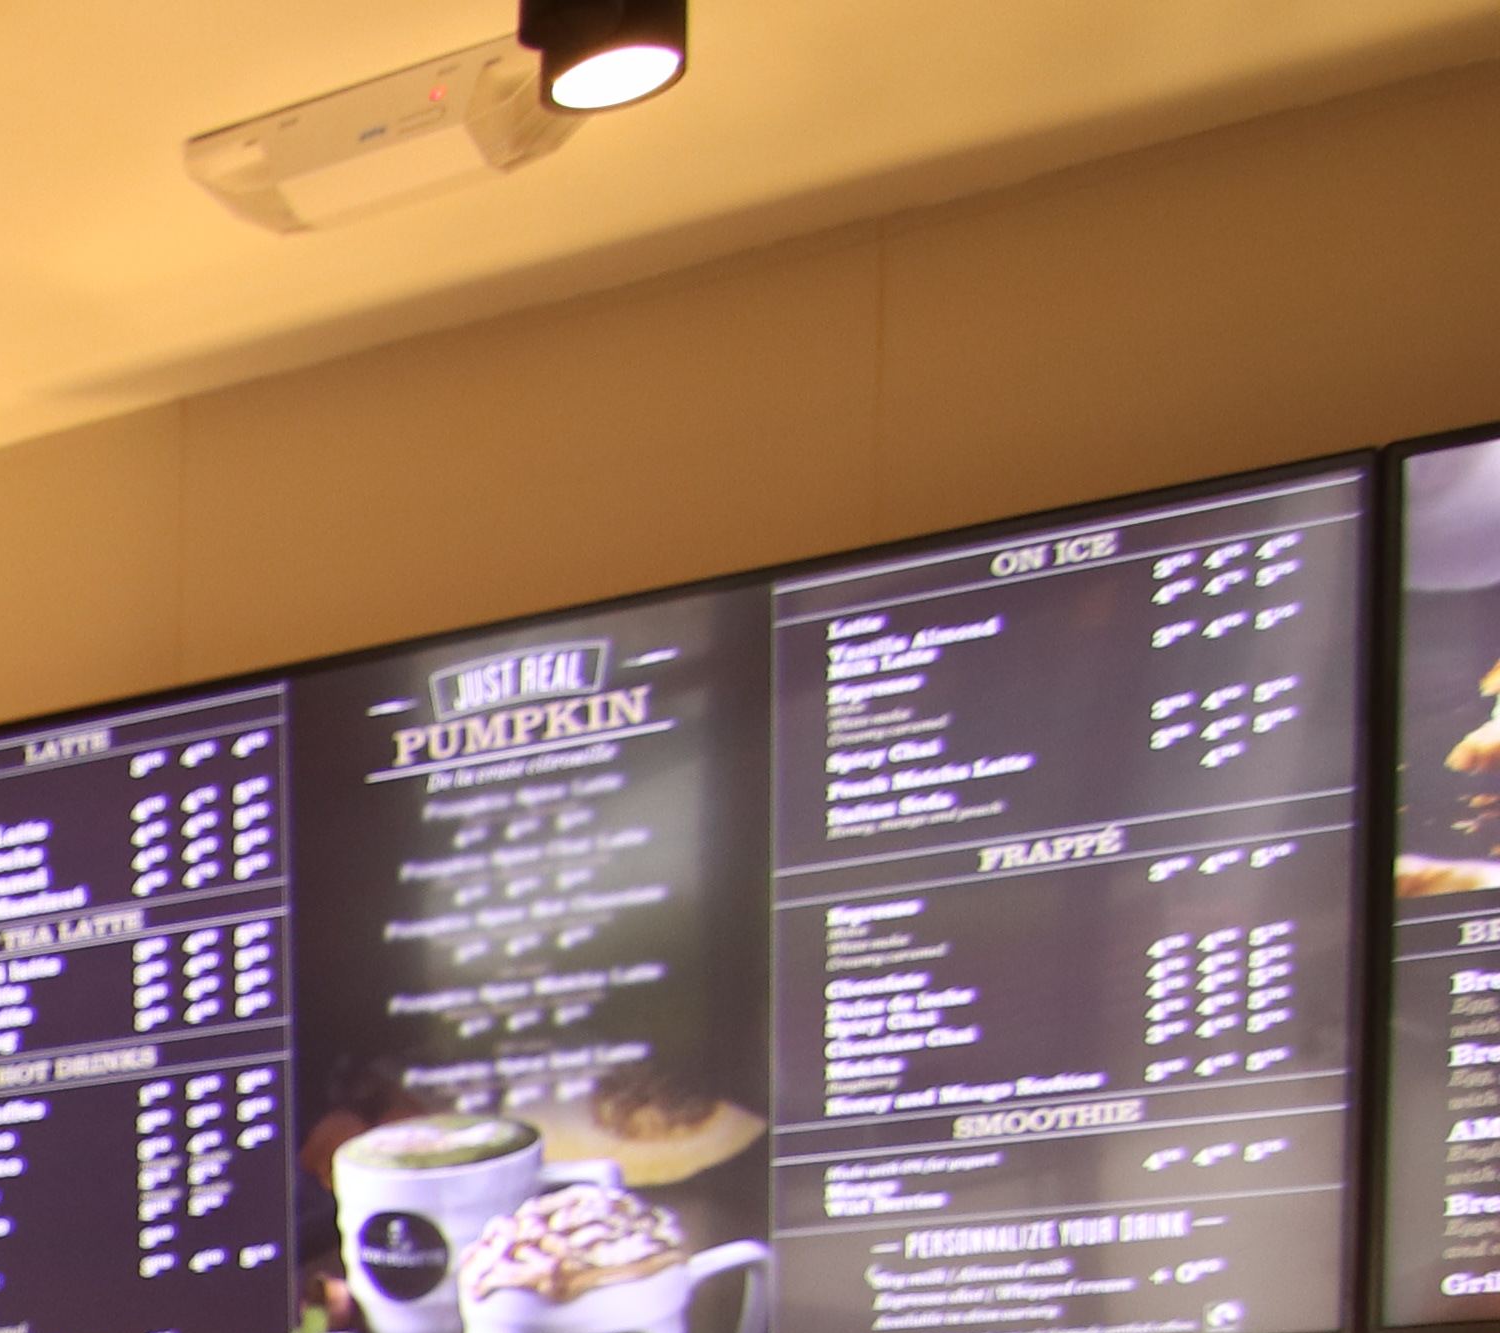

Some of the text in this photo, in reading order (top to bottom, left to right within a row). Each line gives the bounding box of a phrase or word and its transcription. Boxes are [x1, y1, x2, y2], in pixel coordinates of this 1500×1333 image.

[990, 530, 1119, 577] ON ICE
[827, 615, 887, 640] Latte
[827, 615, 1001, 663] Vanilla Almond
[880, 646, 940, 672] Latte
[453, 650, 583, 712] JUST REAL
[392, 684, 650, 768] PUMPKIN
[25, 728, 111, 766] LATTE
[888, 738, 944, 763] Chai
[973, 752, 1035, 778] Latte
[978, 826, 1124, 873] FRAPPÉ
[0, 910, 145, 951] TEA LATTE
[55, 1044, 159, 1080] DRINKS
[953, 1098, 1145, 1140] SMOOTHIE
[1059, 1215, 1118, 1247] YOUR
[1119, 1211, 1190, 1241] DRINK
